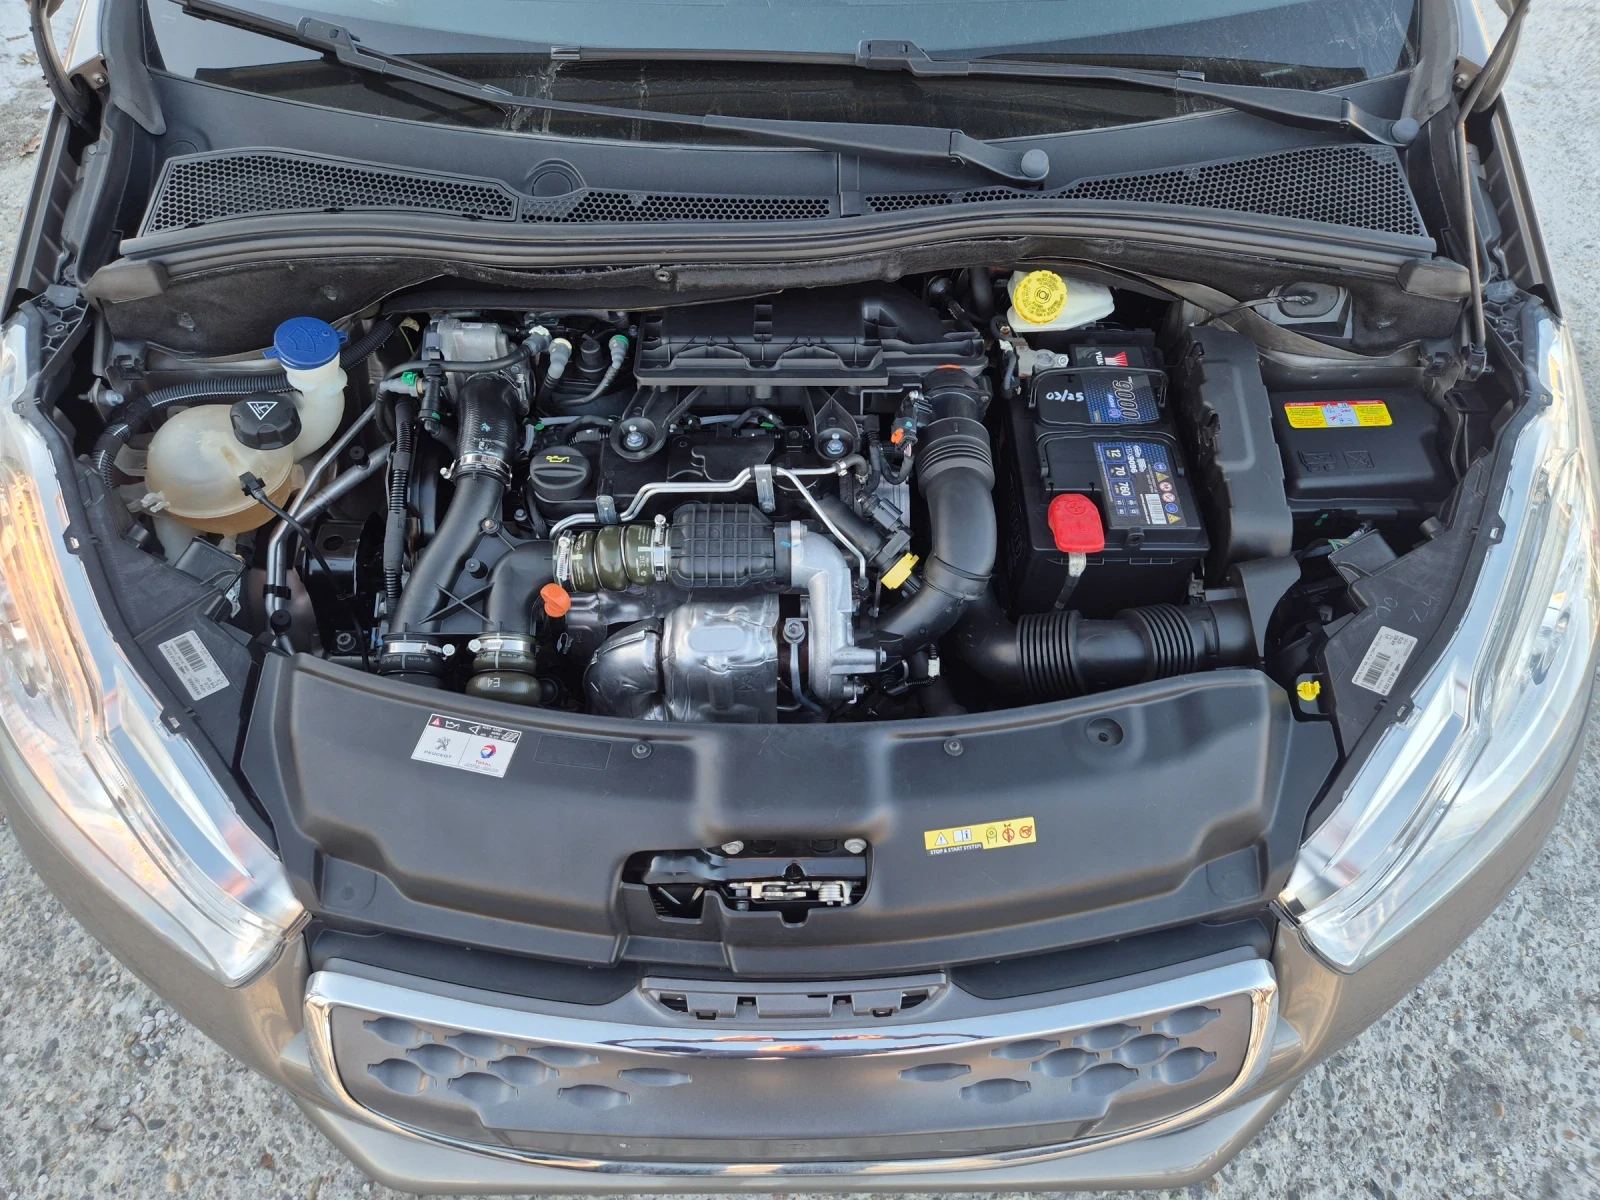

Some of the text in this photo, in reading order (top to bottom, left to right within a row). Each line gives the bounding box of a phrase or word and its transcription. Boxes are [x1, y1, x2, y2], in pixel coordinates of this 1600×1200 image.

[1046, 389, 1084, 402] 03/25
[1112, 380, 1140, 419] 9000
[1111, 449, 1121, 458] 12
[1115, 466, 1126, 476] 70
[1119, 482, 1131, 496] 760
[487, 677, 500, 688] E4
[424, 750, 452, 759] PEUGEOT
